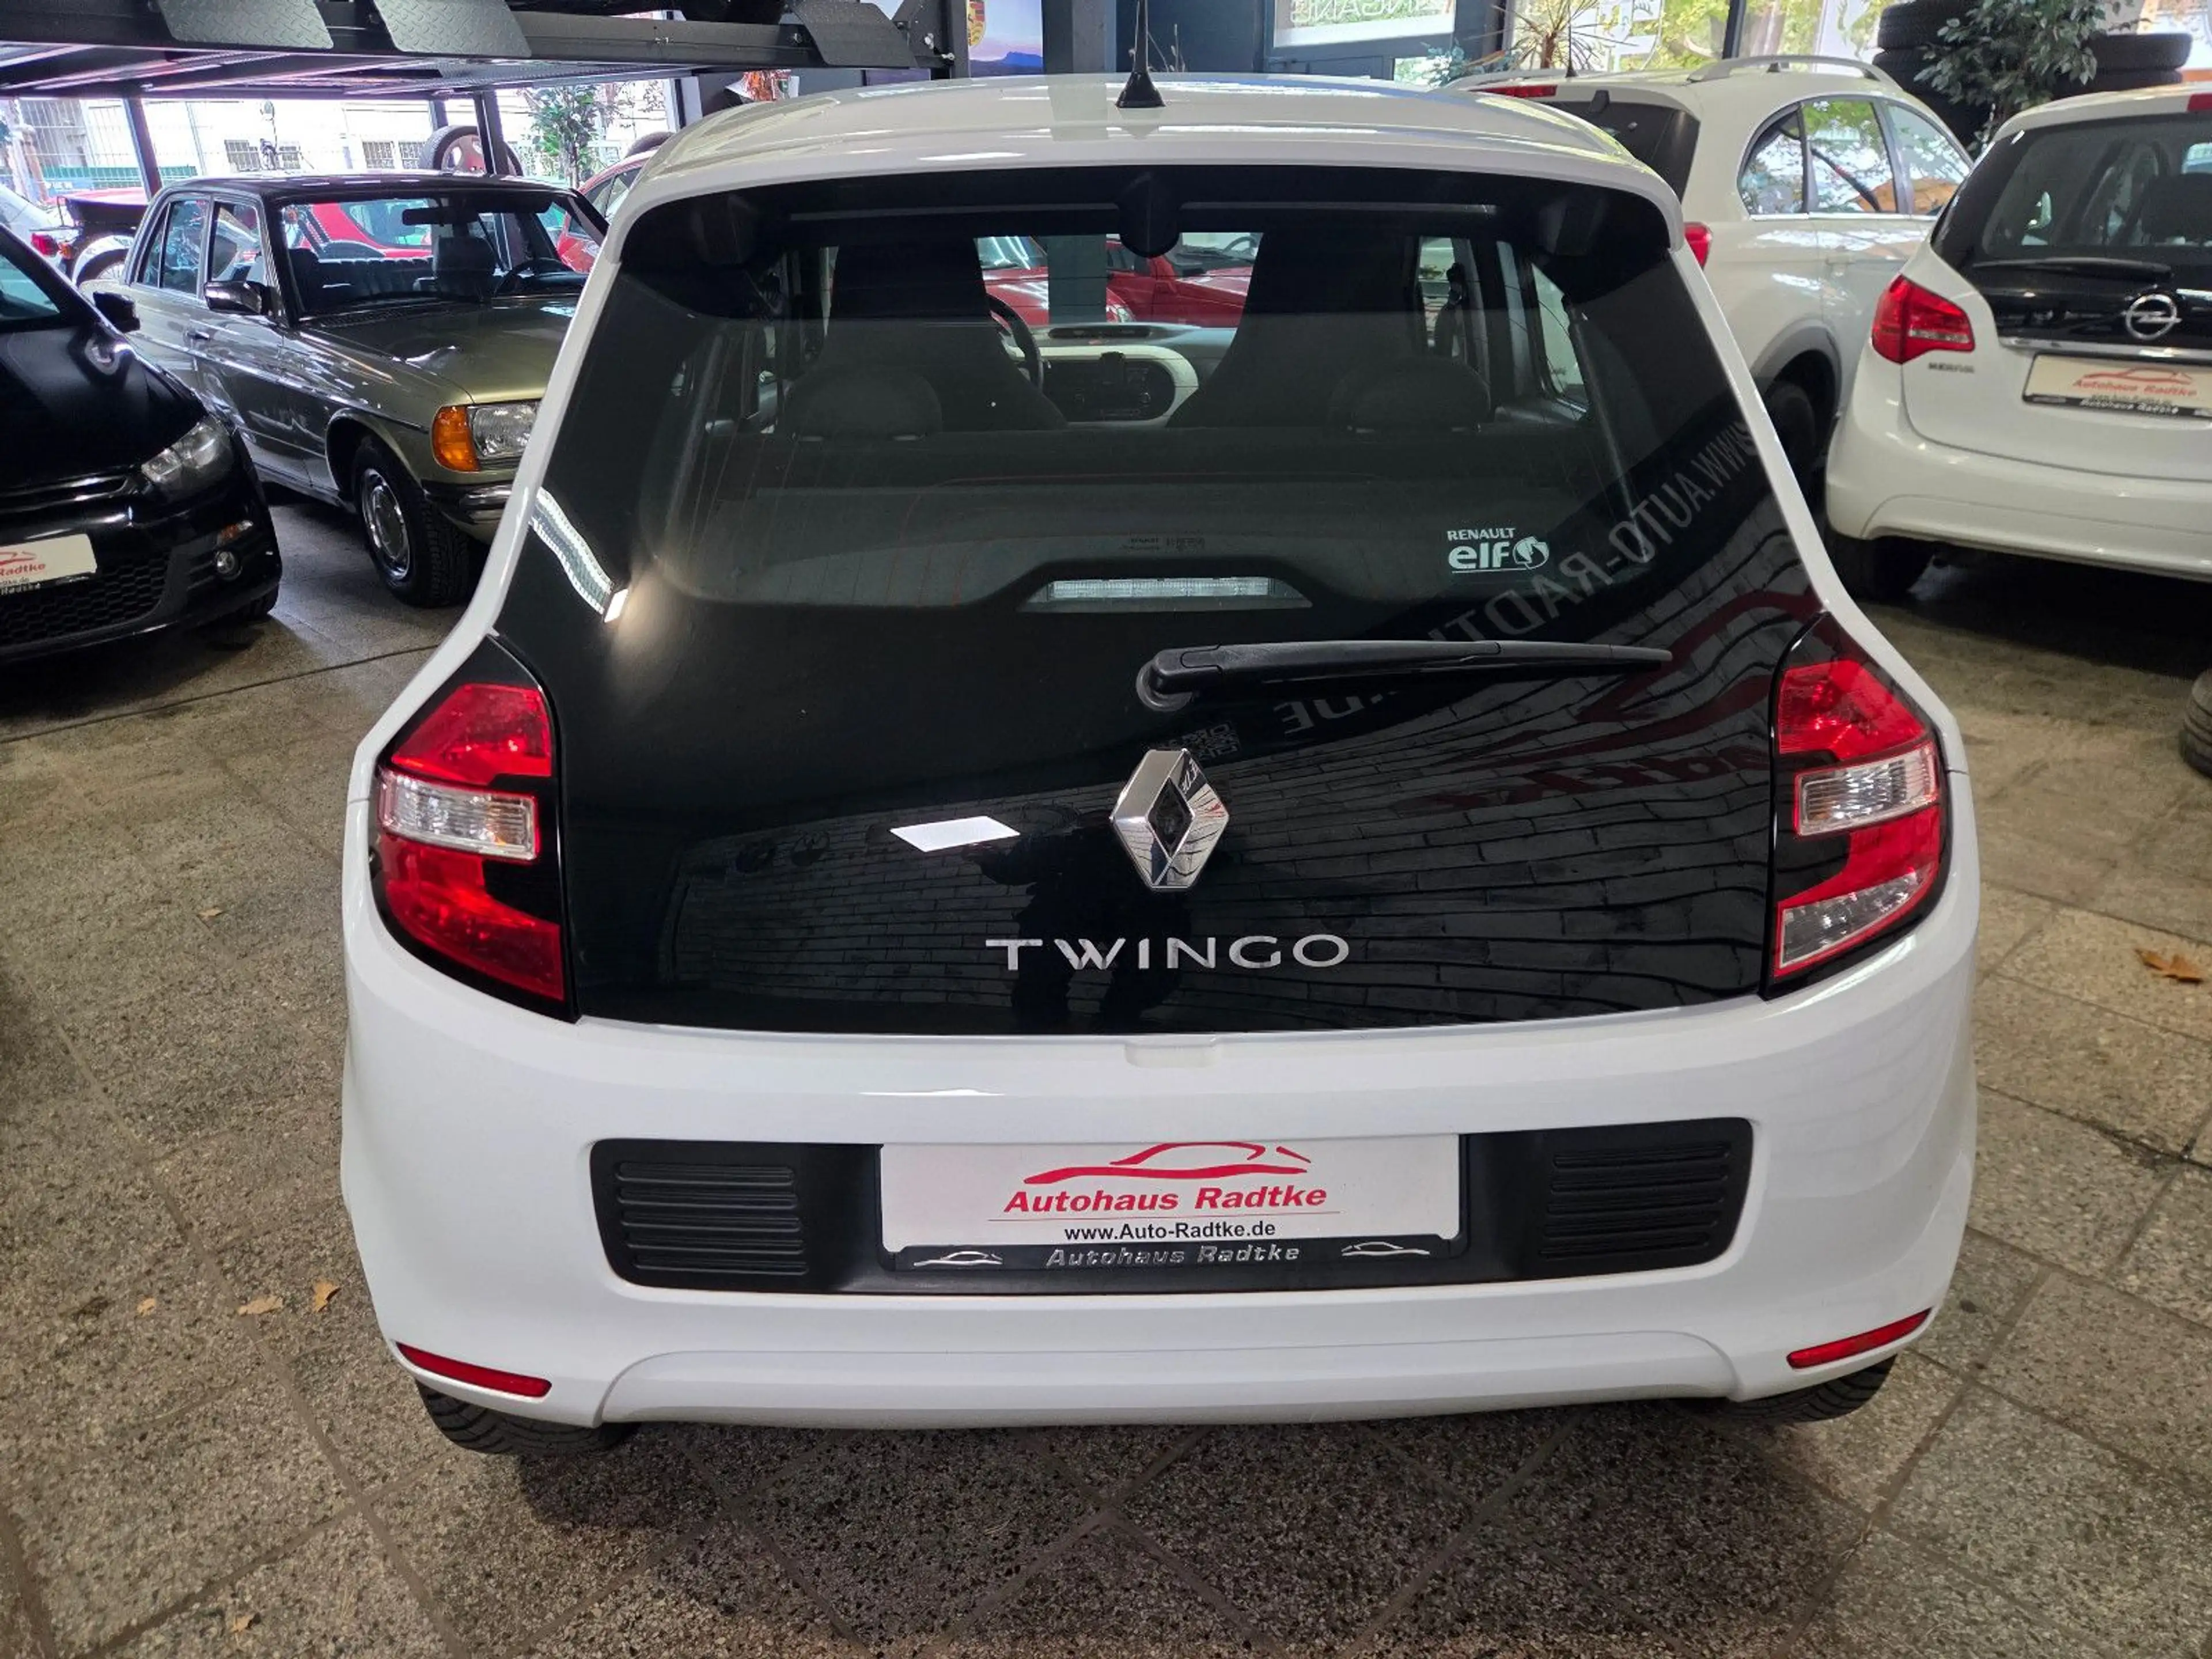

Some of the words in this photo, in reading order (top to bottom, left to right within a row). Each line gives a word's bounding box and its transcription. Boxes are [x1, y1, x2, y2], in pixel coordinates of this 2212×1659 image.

[1447, 527, 1516, 541] RENAULT
[1448, 541, 1510, 570] elf
[985, 933, 1350, 971] TWINGO
[1003, 1190, 1179, 1213] Autohaus
[1194, 1184, 1327, 1210] Radtke
[1064, 1220, 1277, 1241] www.Auto-Radtke.de
[1046, 1245, 1185, 1268] Autohaus
[1196, 1243, 1300, 1263] Radtke
